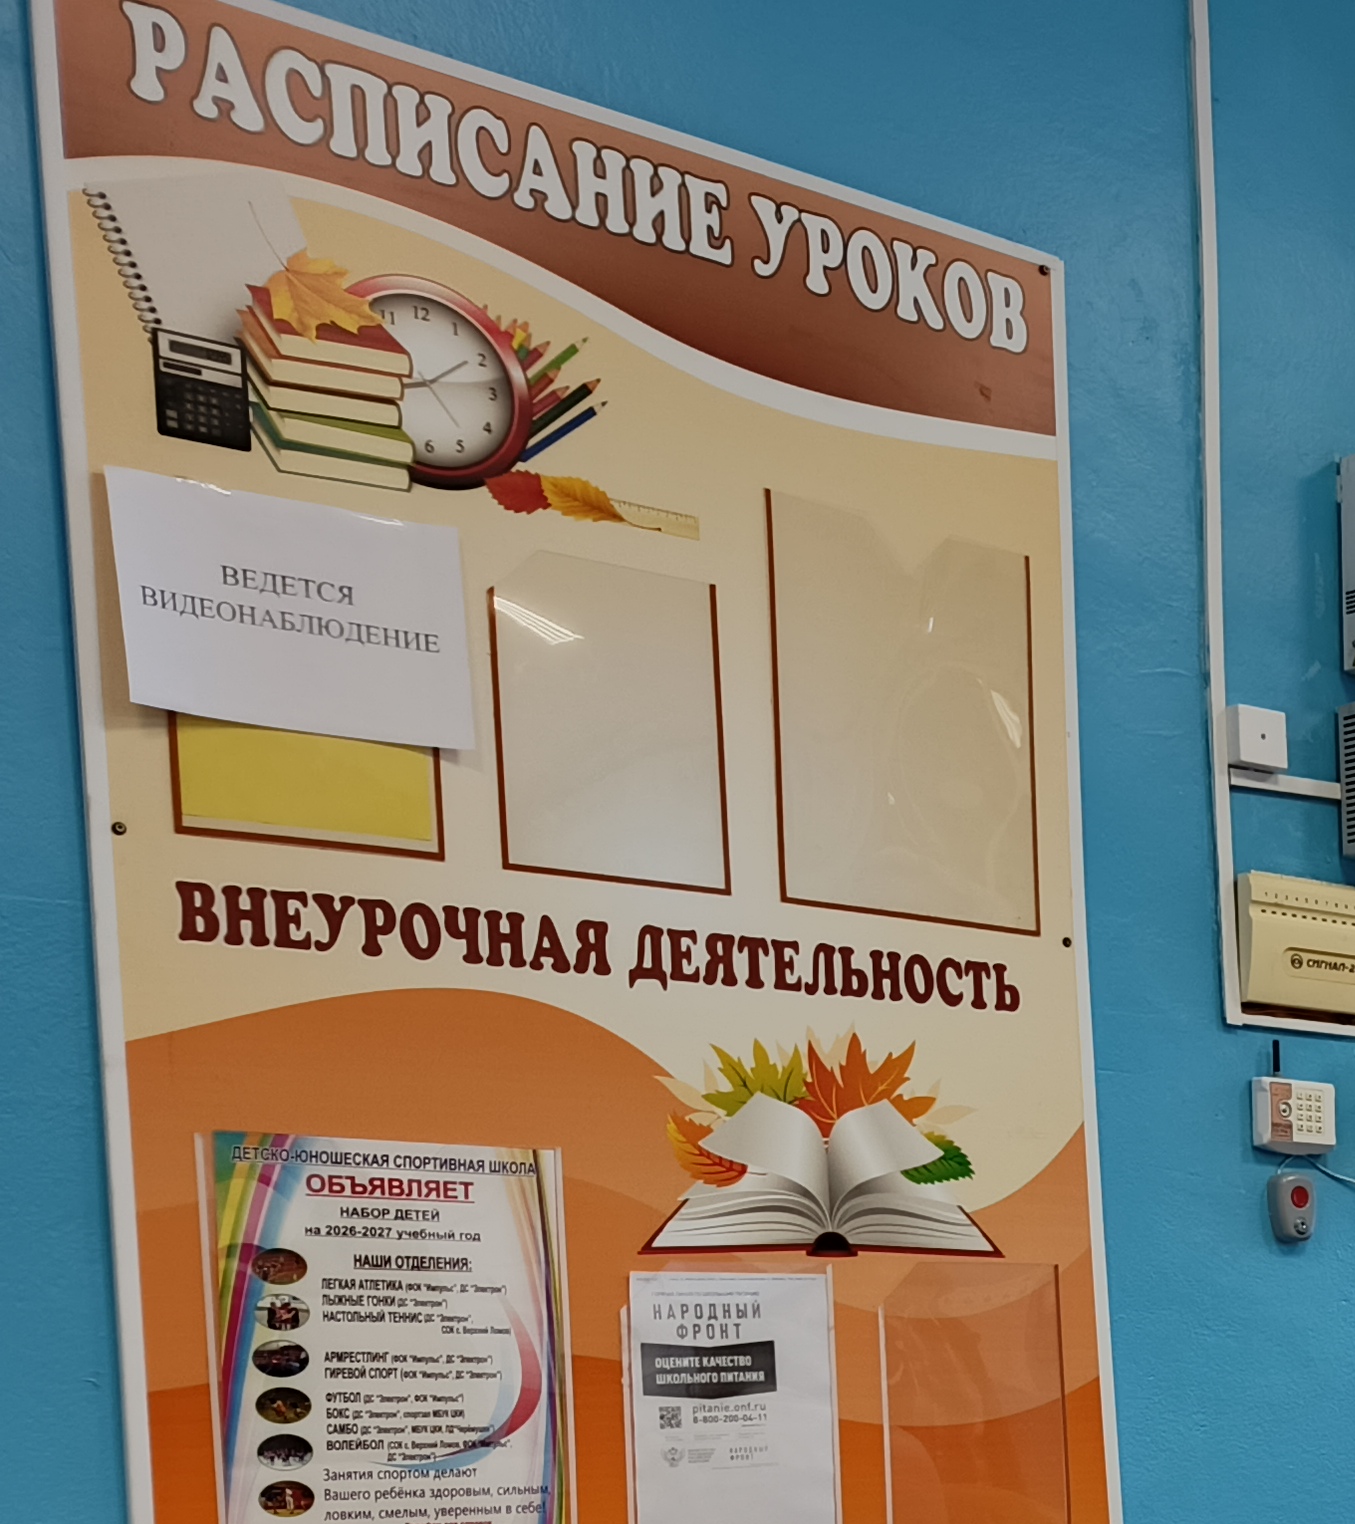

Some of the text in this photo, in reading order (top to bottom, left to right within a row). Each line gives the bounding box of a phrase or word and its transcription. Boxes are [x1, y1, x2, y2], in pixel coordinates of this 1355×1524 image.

[120, 0, 1030, 355] РАСПИСАНИЕ УРОКОВ
[412, 304, 430, 322] 12
[451, 321, 459, 337] 1
[477, 352, 487, 367] 2
[489, 386, 497, 401] 3
[482, 421, 492, 435] 4
[424, 439, 434, 454] 6
[456, 439, 464, 454] 5
[220, 564, 355, 607] ВЕДЕТСЯ
[140, 584, 441, 656] ВИДЕОНАБЛЮДЕНИЕ
[175, 881, 1022, 1012] ВНЕУРОЧНАЯ ДЕЯТЕЛЬНОСТЬ
[231, 1146, 536, 1176] ДЕТСКО-ЮНОШЕСКАЯ СПОРТИВНАЯ ШКОЛА
[306, 1174, 475, 1200] ОБЪЯВЛЯЕТ
[340, 1206, 440, 1221] НАБОР ДЕТЕЙ
[305, 1225, 481, 1242] на 2026-2027 учебный год
[353, 1254, 472, 1272] НАШИ ОТДЕЛЕНИЯ:
[321, 1278, 356, 1291] ЛЕГКАЯ
[358, 1279, 403, 1292] АТЛЕТИКА
[367, 1295, 396, 1307] ГОНКИ
[322, 1309, 385, 1323] НАСТОЛЬНЫЙ
[388, 1311, 423, 1323] ТЕННИС
[653, 1300, 761, 1321] НАРОДНЫЙ
[676, 1323, 742, 1340] ФРОНТ
[655, 1355, 752, 1370] ОЦЕНИТЕ КАЧЕСТВО
[324, 1366, 366, 1379] ГИРЕВОЙ
[368, 1367, 398, 1379] СПОРТ
[656, 1371, 765, 1385] ШКОЛЬНОГО ПИТАНИЯ
[325, 1392, 361, 1404] ФУТБОЛ
[326, 1408, 350, 1420] БОКС
[326, 1423, 359, 1435] САМБО
[326, 1438, 384, 1451] ВОЛЕЙБОЛ
[323, 1467, 477, 1483] Занятия спортом делают
[324, 1484, 551, 1502] Вашего ребёнка здоровым, сильным,
[324, 1501, 546, 1521] ловким, смелым, уверенным в себе!
